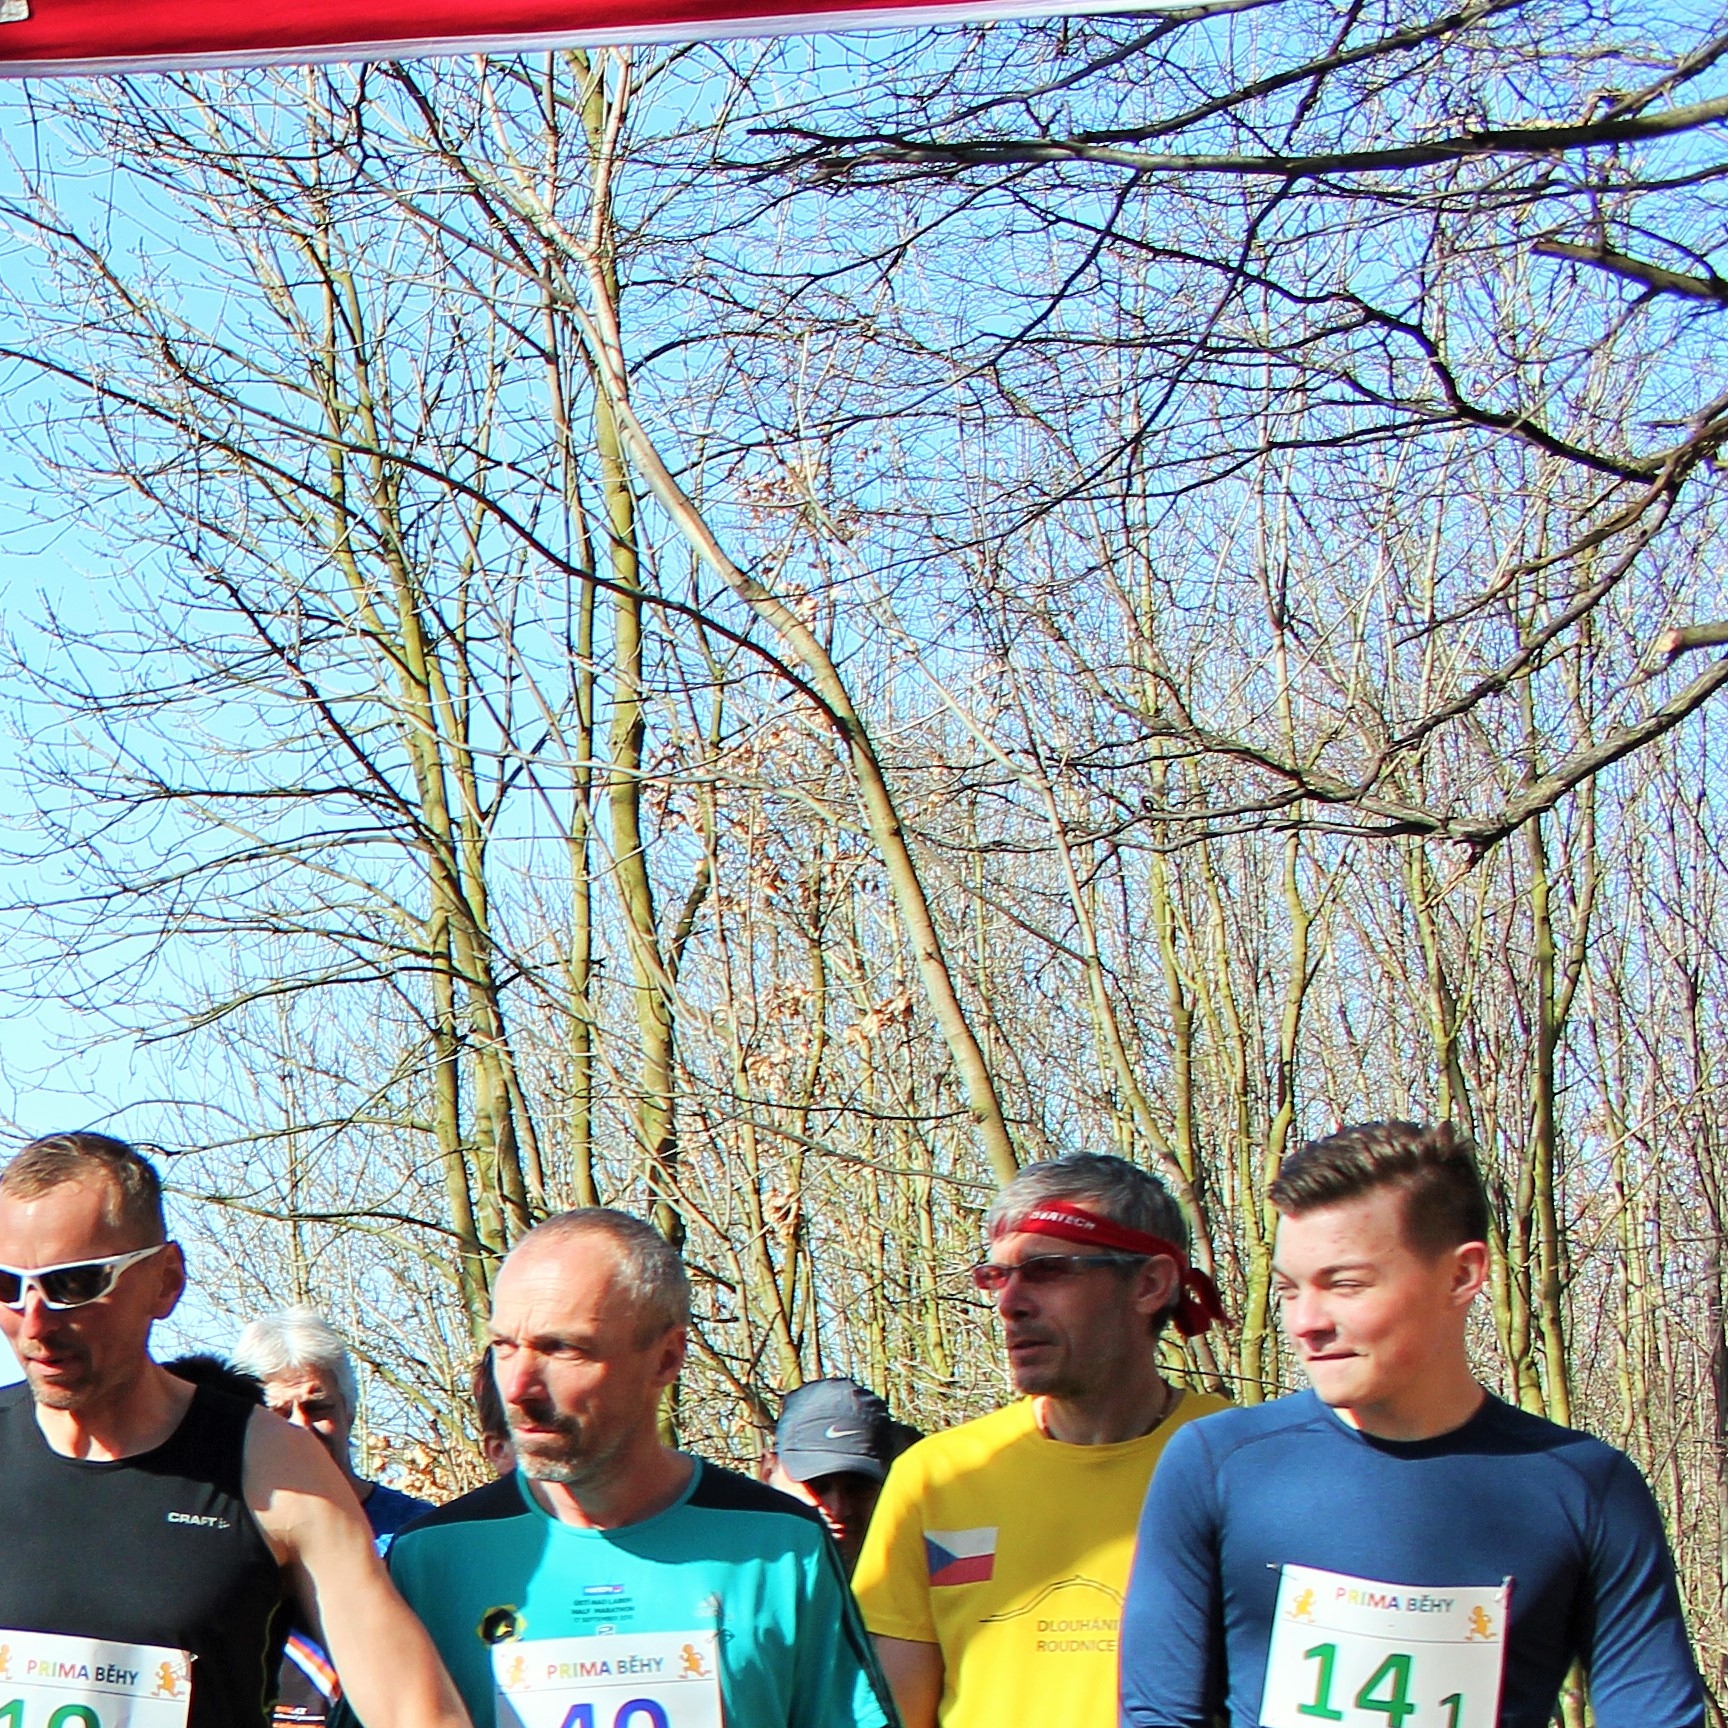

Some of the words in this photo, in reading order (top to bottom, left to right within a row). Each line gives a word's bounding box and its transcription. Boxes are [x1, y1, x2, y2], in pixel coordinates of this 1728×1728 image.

[167, 1511, 218, 1527] CRAFT
[1336, 1587, 1400, 1610] PRIMA
[1406, 1594, 1455, 1613] BĚHY
[1037, 1639, 1116, 1653] ROUDNICE
[26, 1659, 89, 1681] PRIMA
[95, 1664, 139, 1686] BĚHY
[547, 1660, 612, 1679] PRIMA
[616, 1655, 664, 1675] BĚHY
[1297, 1642, 1416, 1728] 14
